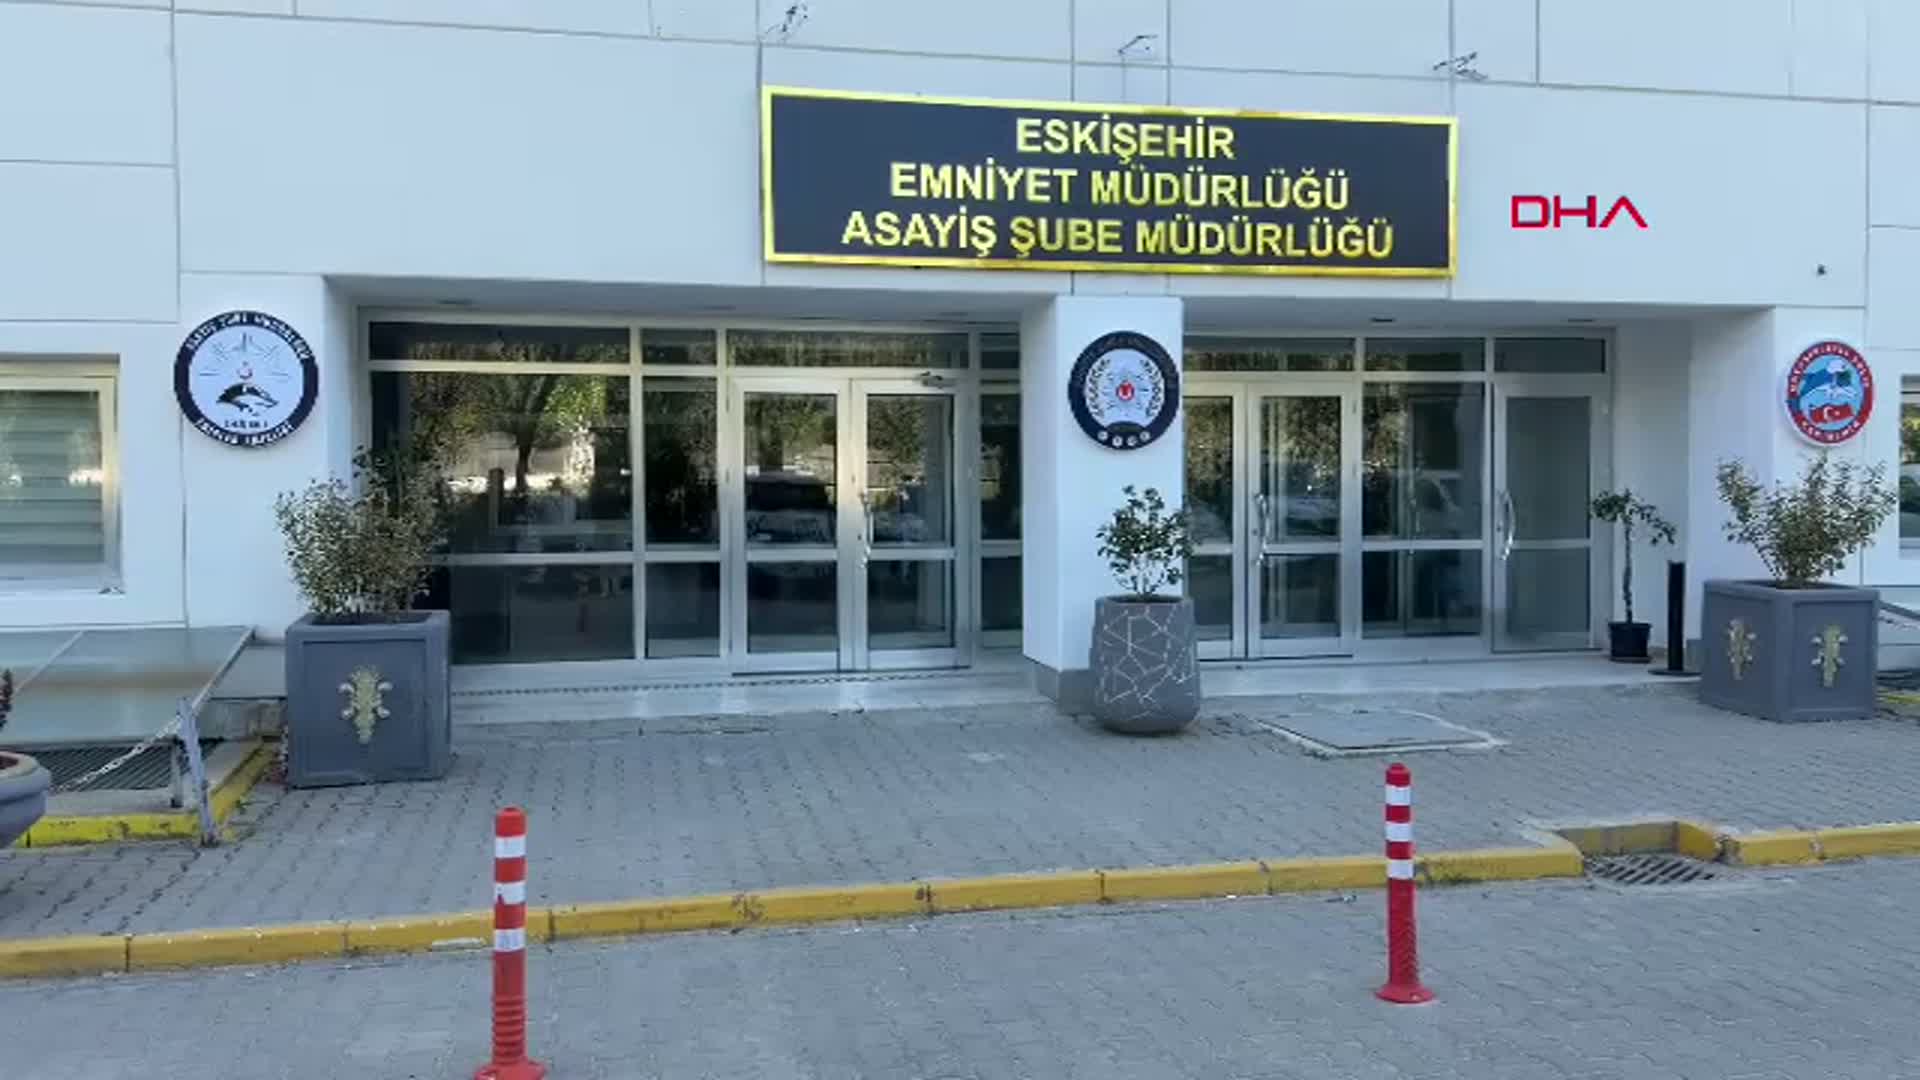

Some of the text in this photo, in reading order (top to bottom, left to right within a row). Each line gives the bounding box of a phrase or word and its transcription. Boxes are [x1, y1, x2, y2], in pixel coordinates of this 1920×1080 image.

[1016, 114, 1235, 165] ESKİŞEHİR
[890, 157, 1349, 210] EMNİYET MÜDÜRLÜĞÜ
[841, 205, 1394, 259] ASAYİŞ ŞUBE MÜDÜRLÜĞÜ
